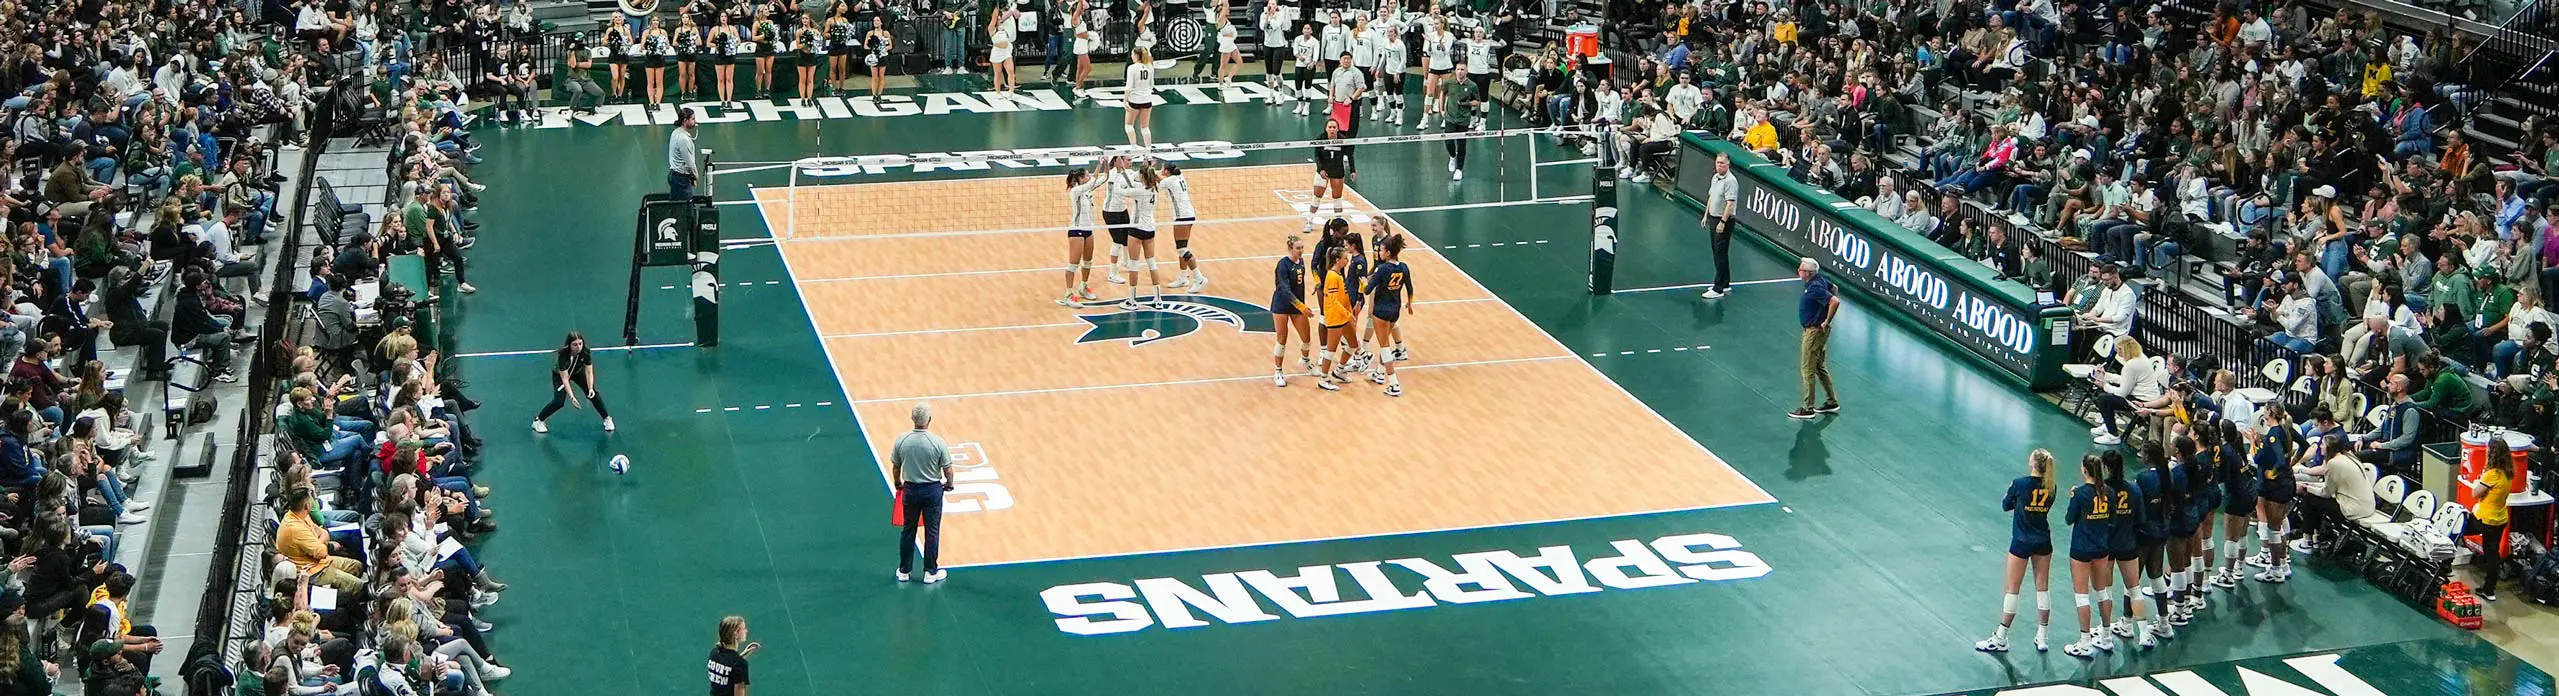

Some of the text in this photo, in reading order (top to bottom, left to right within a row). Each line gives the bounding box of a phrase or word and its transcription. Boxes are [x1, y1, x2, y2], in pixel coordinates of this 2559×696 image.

[1140, 69, 1149, 81] 10
[533, 88, 1073, 129] MICHIGAN
[701, 223, 717, 231] MSU
[1746, 185, 1800, 233] BOOD
[1804, 215, 1872, 270] ABOOD
[1297, 274, 1303, 285] 5
[1875, 251, 1949, 310] ABOOD
[1952, 291, 2034, 354] ABOOD
[2030, 488, 2049, 507] 17
[2092, 494, 2109, 514] 16
[1039, 532, 1774, 637] SPARTANS
